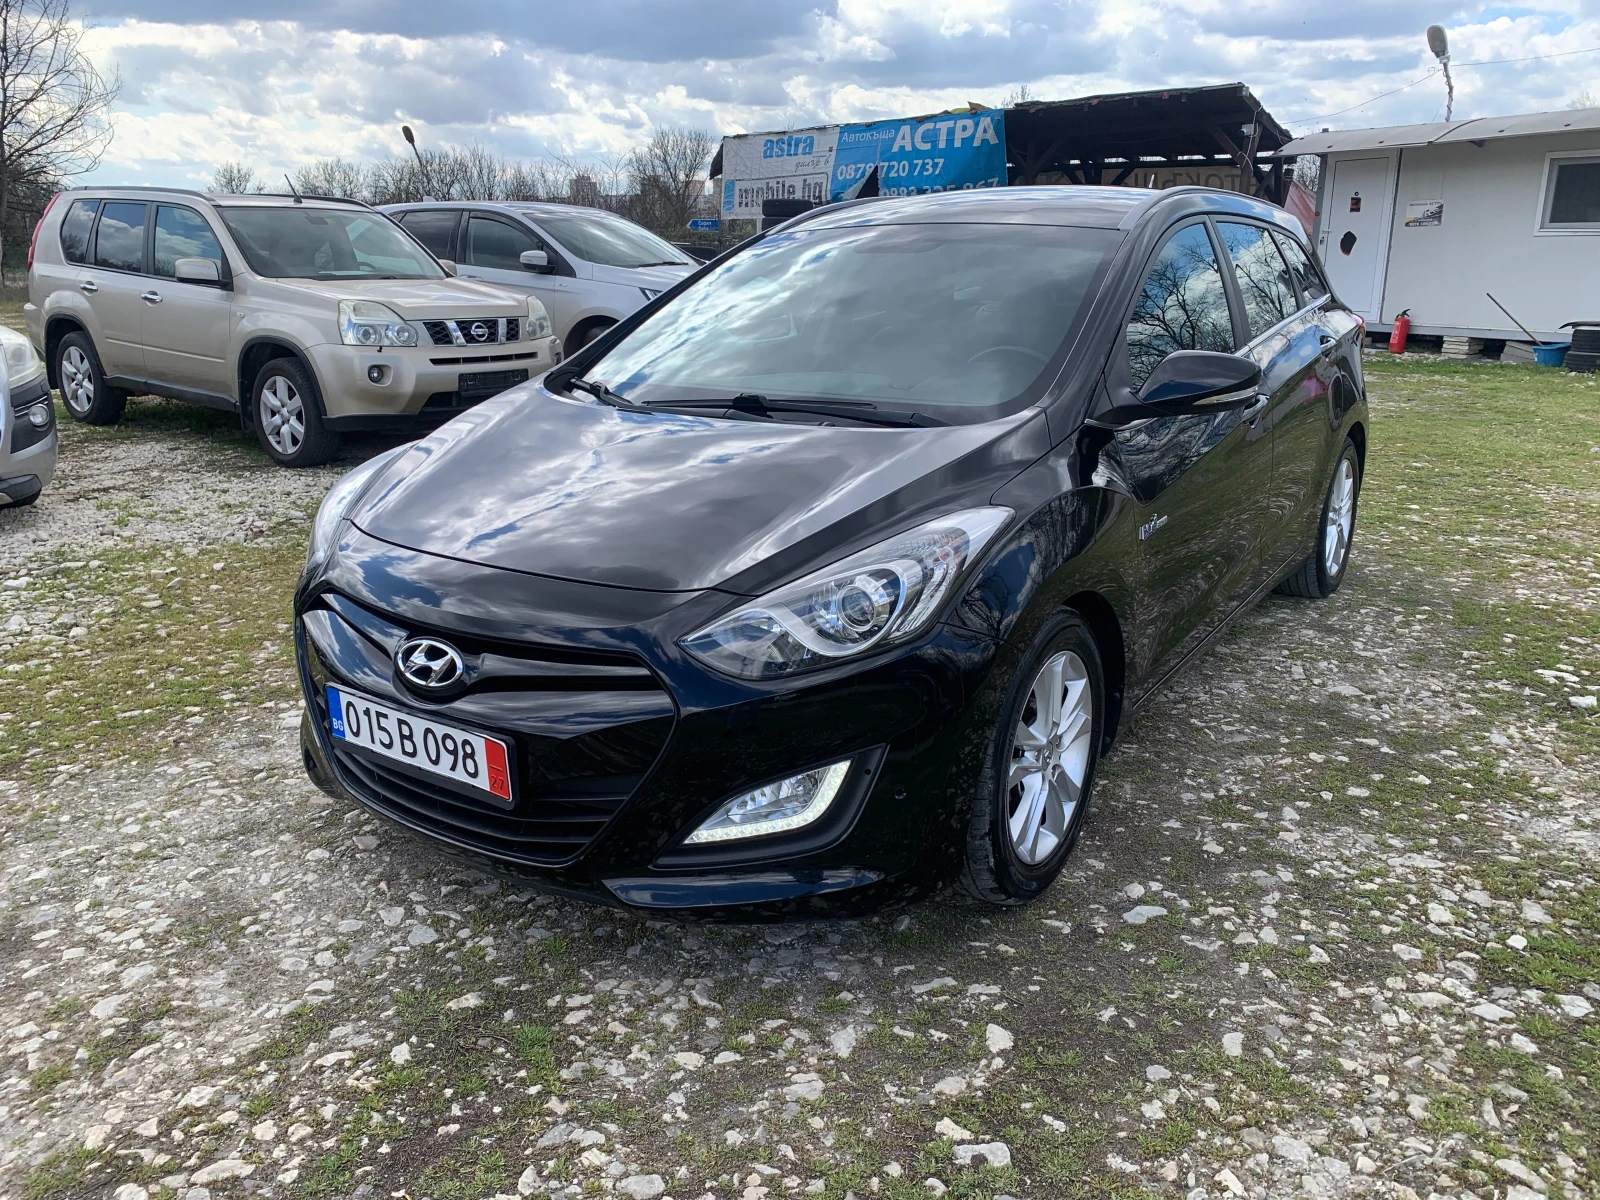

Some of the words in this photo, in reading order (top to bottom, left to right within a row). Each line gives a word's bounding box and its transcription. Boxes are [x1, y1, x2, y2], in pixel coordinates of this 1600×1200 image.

[840, 128, 895, 143] Автокъща
[891, 116, 999, 152] АСТРА
[762, 135, 815, 159] astra
[880, 160, 909, 178] 720
[913, 158, 945, 176] 737
[332, 717, 344, 731] BG
[491, 774, 504, 791] 27
